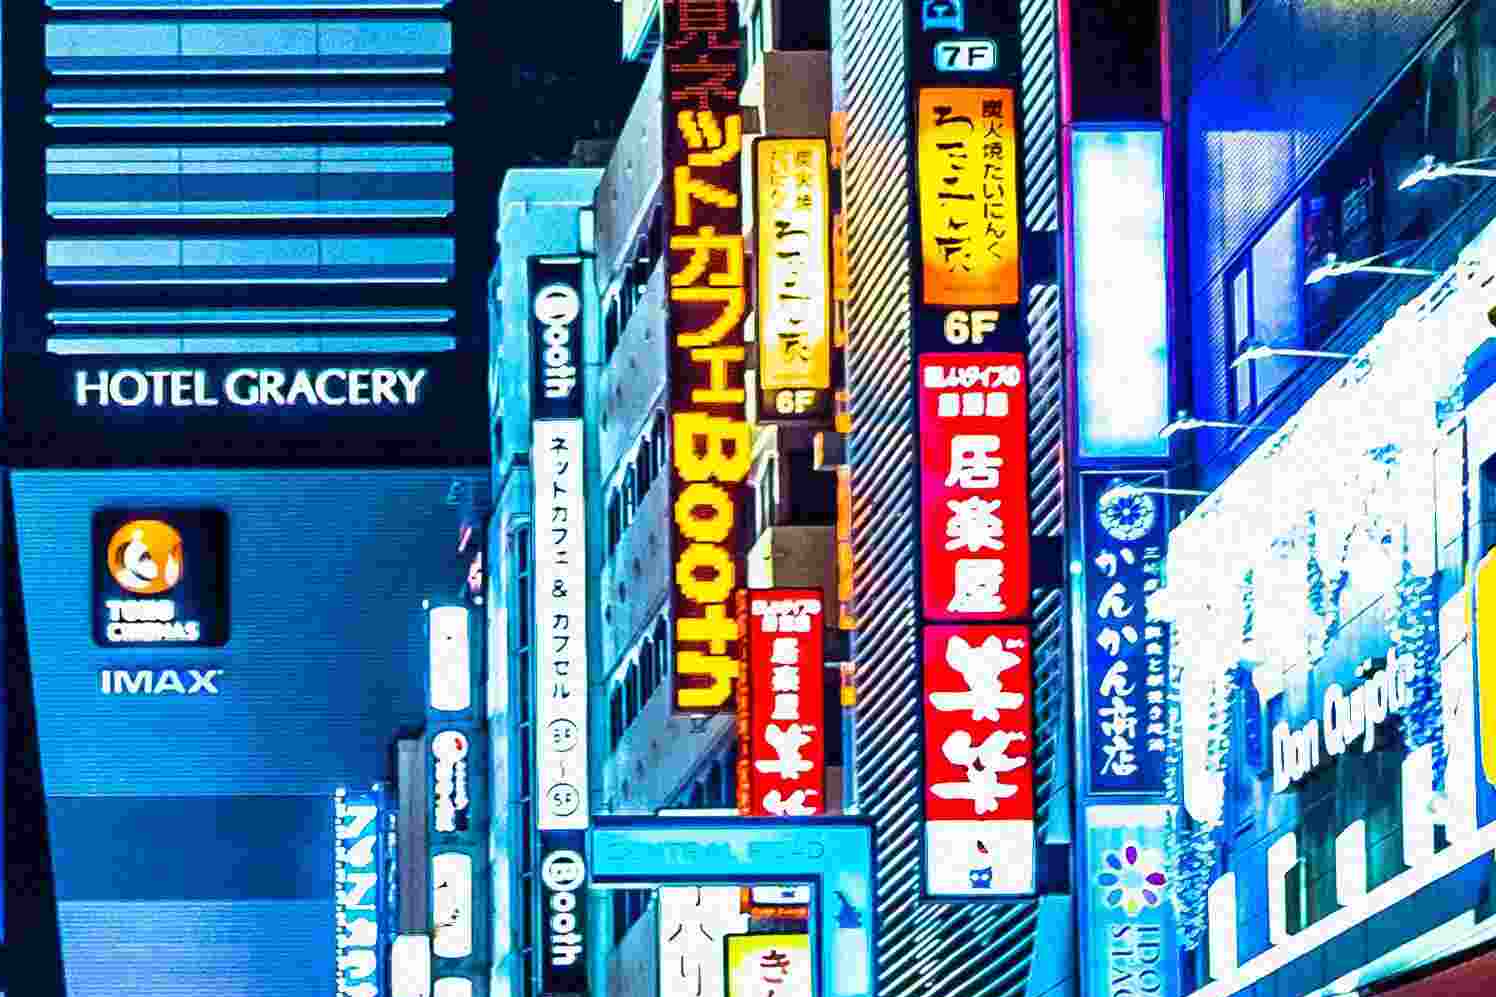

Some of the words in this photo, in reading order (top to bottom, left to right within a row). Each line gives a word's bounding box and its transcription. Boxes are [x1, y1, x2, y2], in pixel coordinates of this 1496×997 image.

[942, 46, 988, 66] 7F
[535, 284, 579, 398] Booth
[944, 311, 1000, 344] 6F
[75, 369, 218, 406] HOTEL
[224, 368, 427, 406] GRACERY
[775, 390, 816, 413] 6F
[99, 669, 220, 695] IMAX
[1272, 718, 1320, 794] Don
[542, 850, 585, 965] Booth
